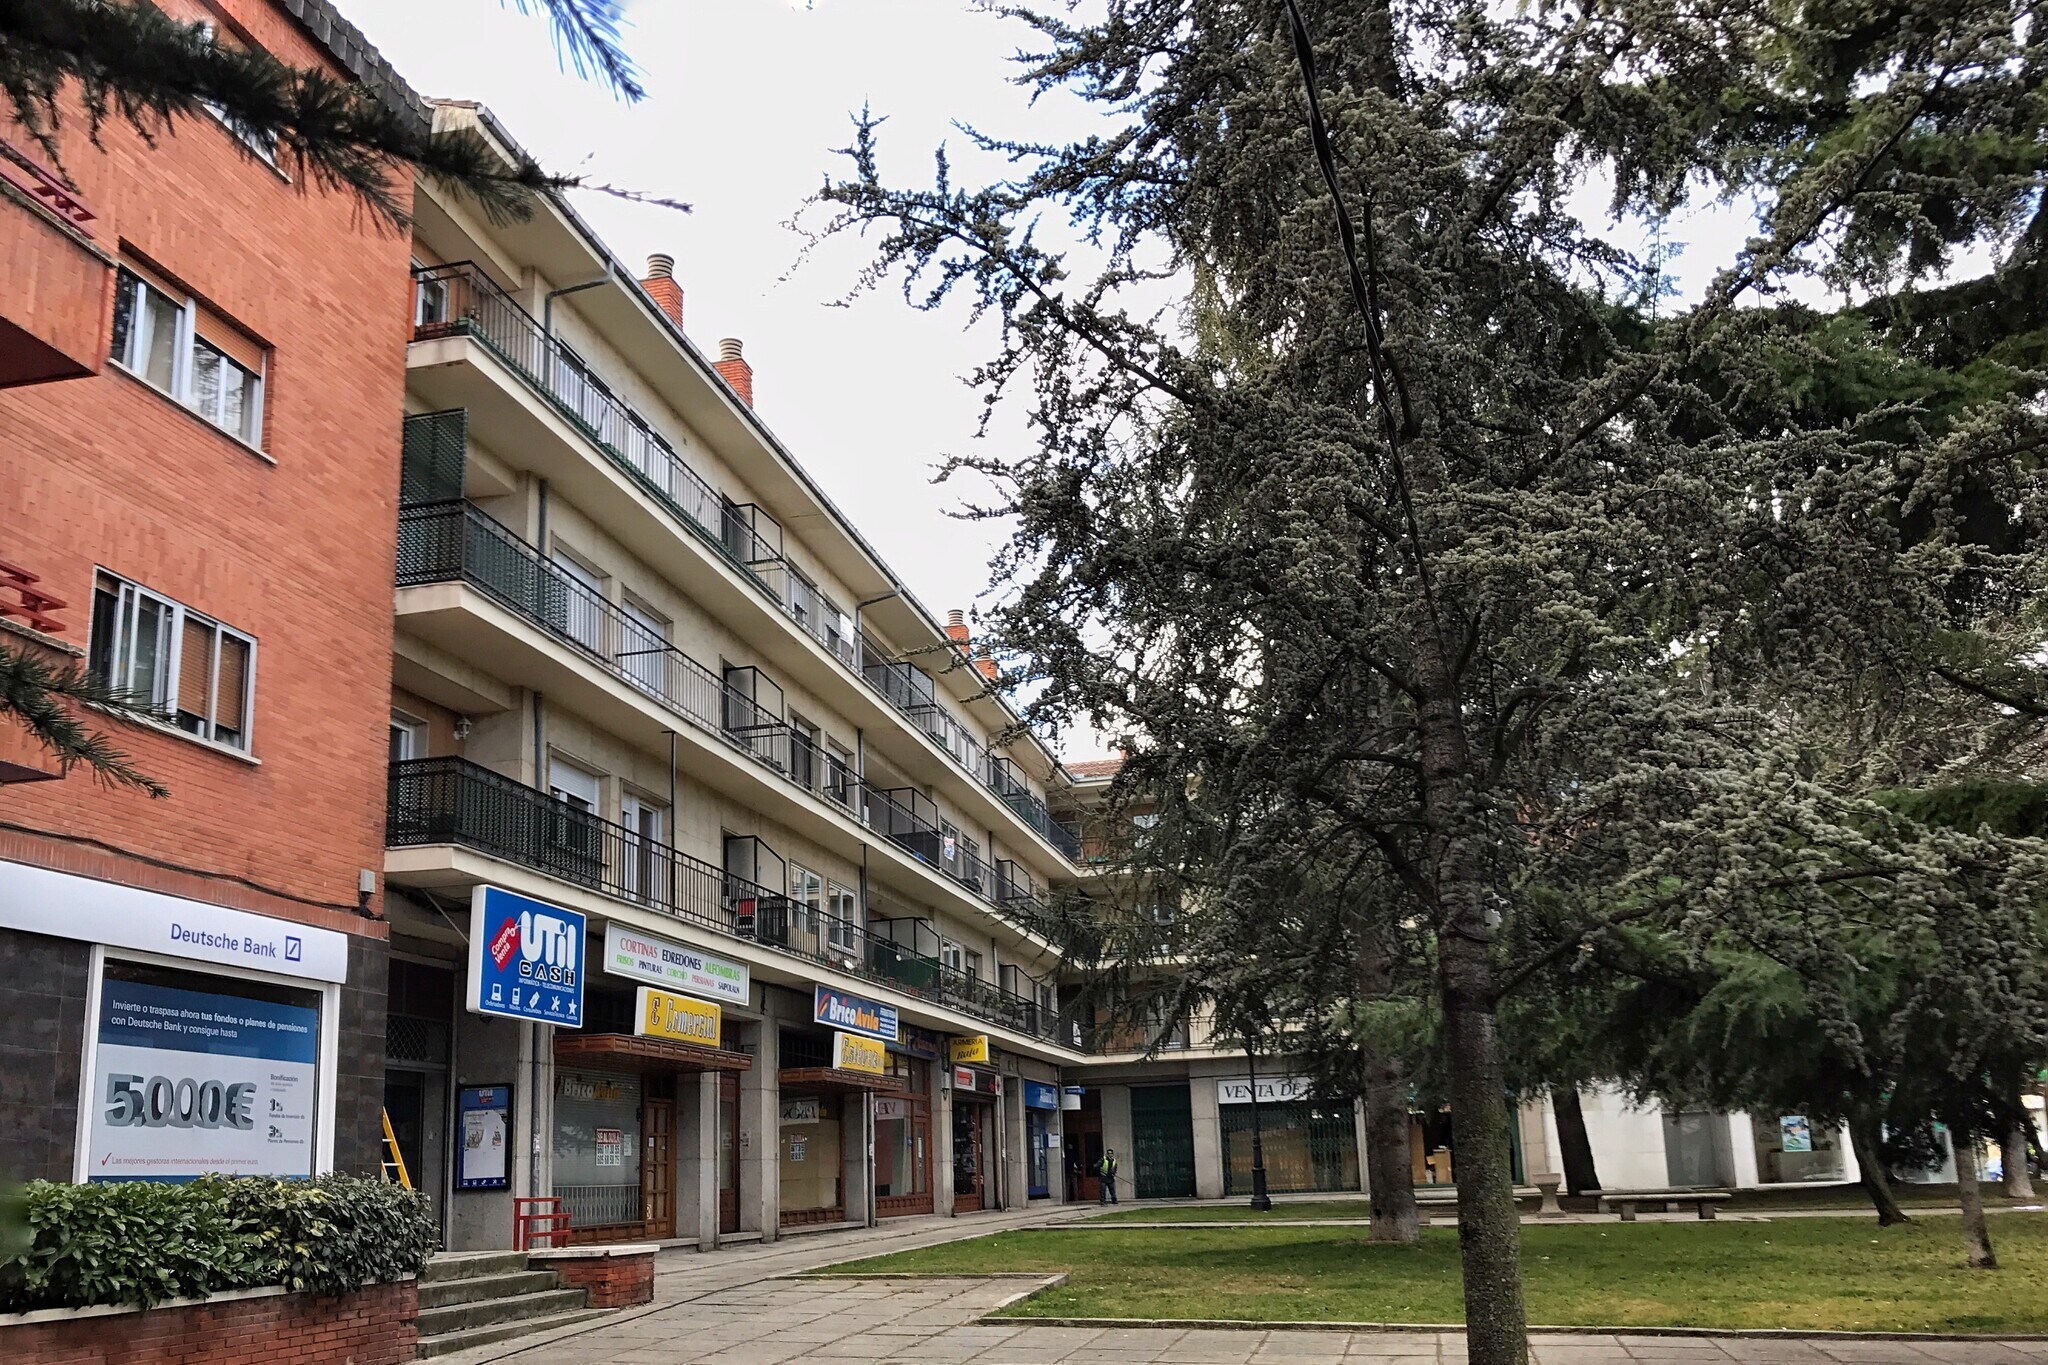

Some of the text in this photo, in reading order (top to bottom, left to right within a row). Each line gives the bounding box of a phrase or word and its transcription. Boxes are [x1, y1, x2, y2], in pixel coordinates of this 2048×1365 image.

[170, 923, 276, 958] Deutsche Bank
[519, 960, 576, 987] CASH
[620, 937, 740, 981] CORTINAS EDREDONES ALFOMBRAS
[638, 960, 662, 974] PINTURAS
[111, 1016, 237, 1038] con Deutsche Bank y consigue hasta
[112, 1000, 140, 1012] Invierte
[150, 1005, 179, 1017] traspasa
[180, 1009, 199, 1019] ahora
[201, 1012, 213, 1020] tus
[214, 1013, 237, 1024] fondos
[245, 1018, 267, 1028] planes
[268, 1020, 276, 1029] de
[277, 1023, 308, 1033] pensiones
[665, 998, 717, 1039] Comercial
[104, 1073, 257, 1130] 5.000€
[1224, 1084, 1275, 1098] VENTA
[112, 1156, 122, 1164] Las
